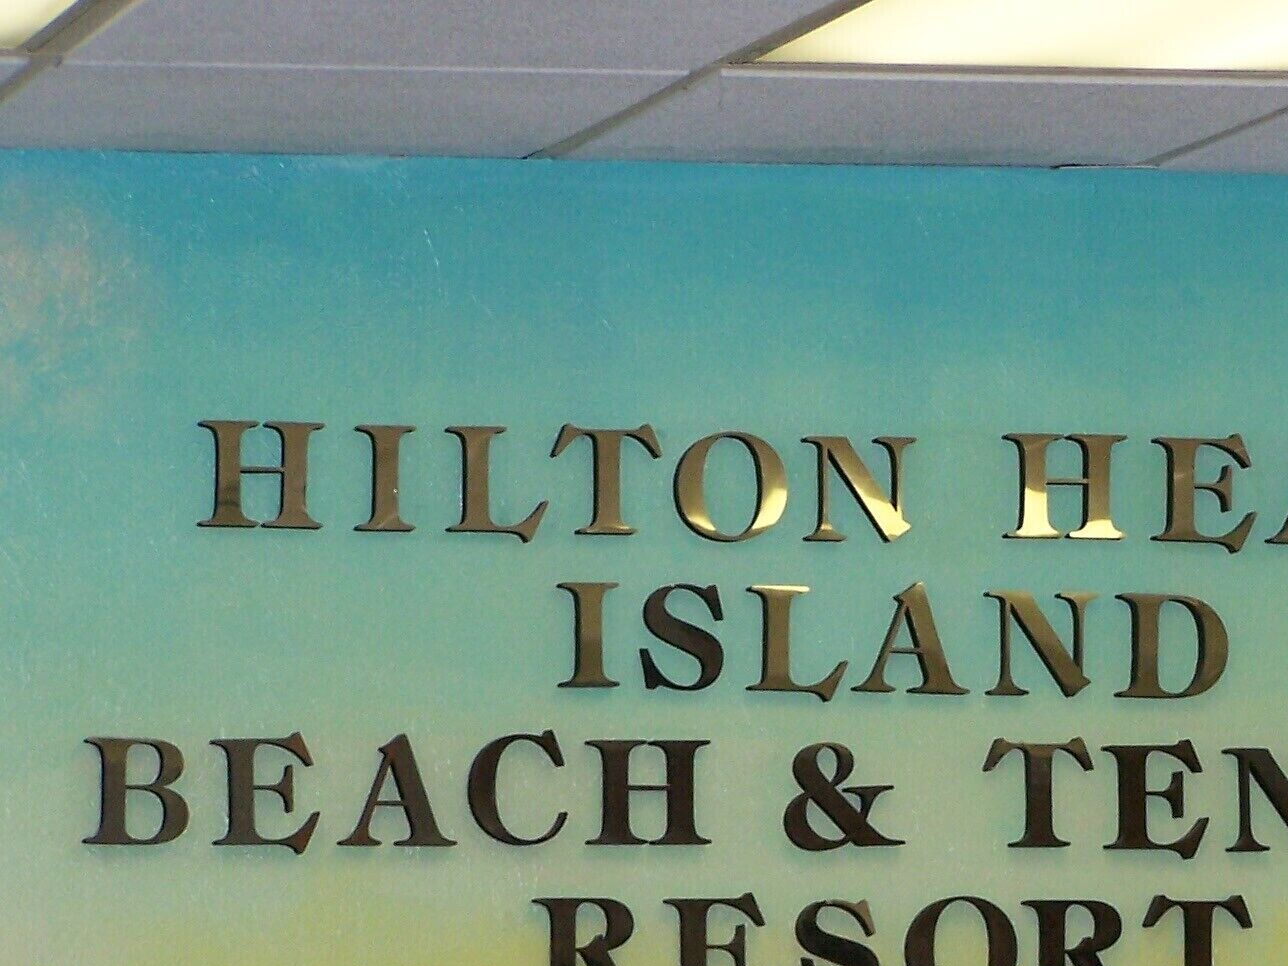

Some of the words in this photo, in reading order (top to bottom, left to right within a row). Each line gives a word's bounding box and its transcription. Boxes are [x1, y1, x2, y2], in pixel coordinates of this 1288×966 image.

[196, 419, 917, 543] HILTON
[556, 581, 1230, 702] ISLAND
[82, 730, 712, 855] BEACH
[783, 741, 906, 852] &
